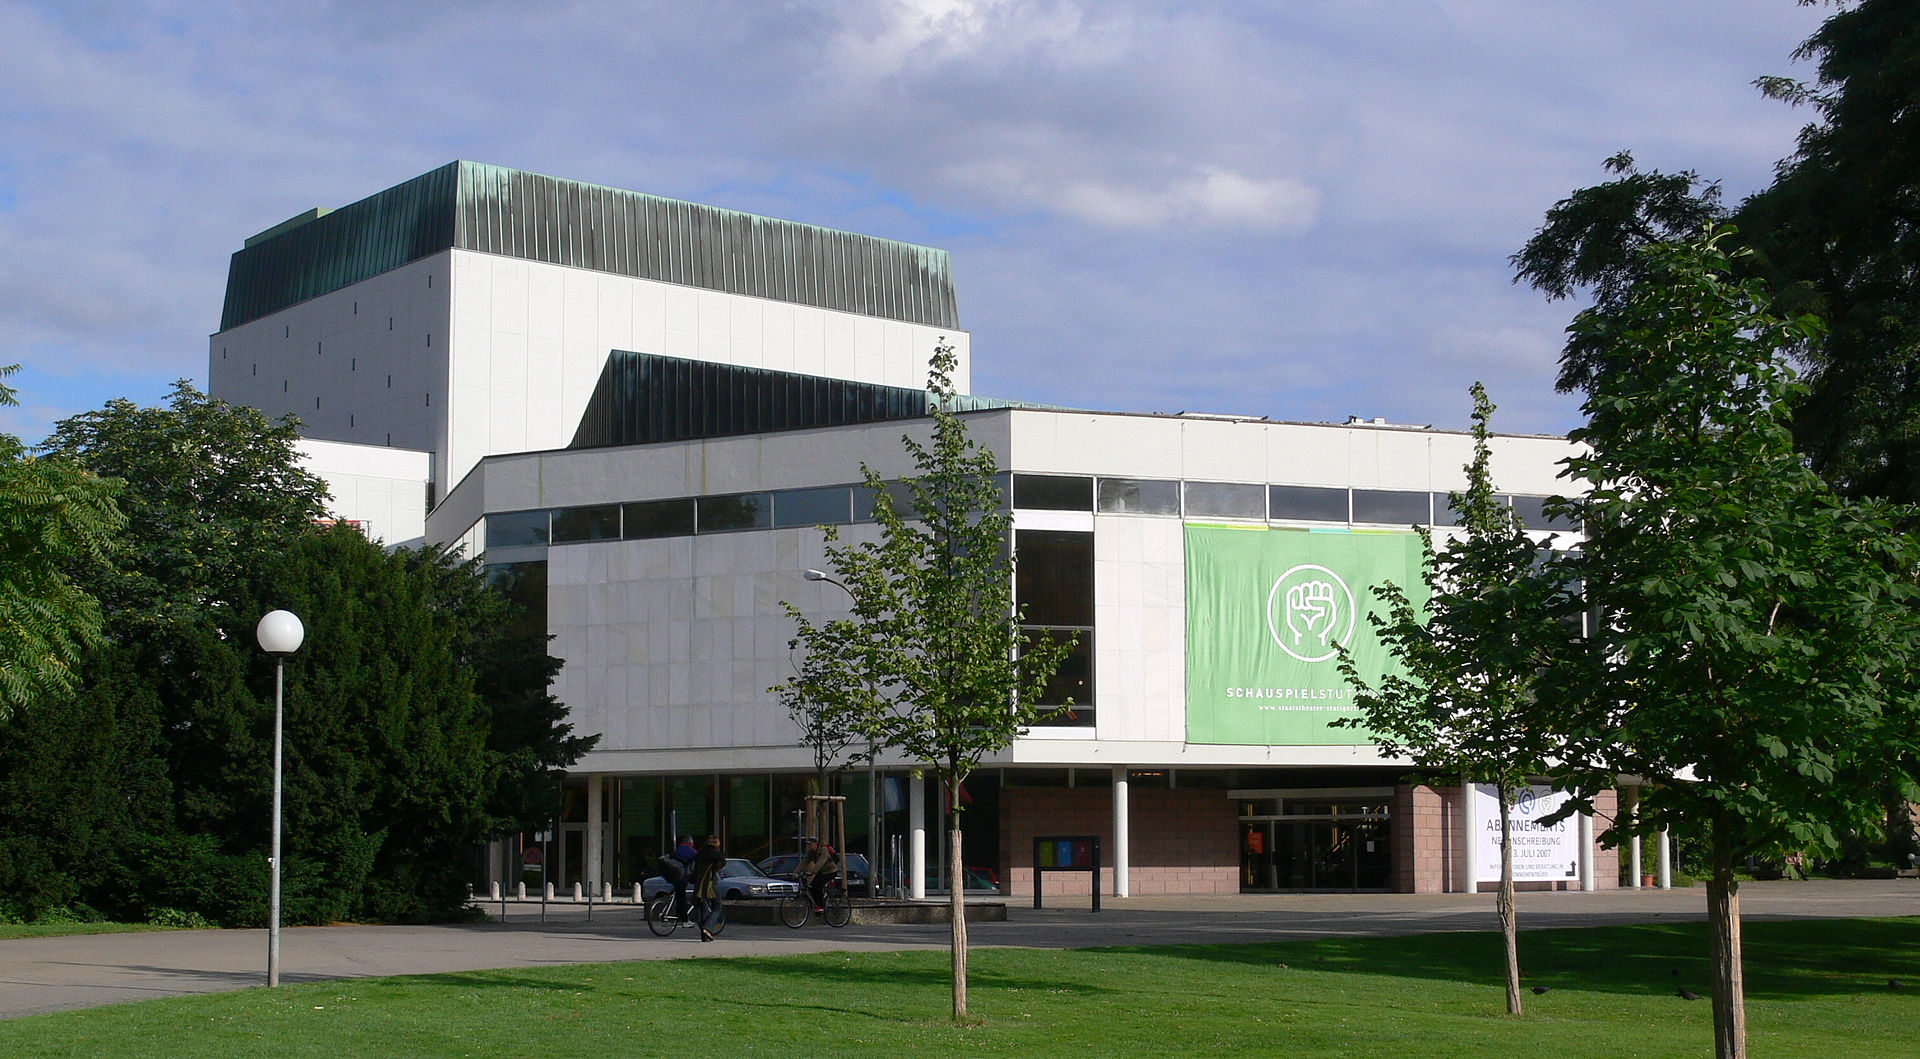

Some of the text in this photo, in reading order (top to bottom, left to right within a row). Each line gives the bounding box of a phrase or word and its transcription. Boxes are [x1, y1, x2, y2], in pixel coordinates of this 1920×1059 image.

[1486, 819, 1566, 832] ABNNEMETS
[1491, 836, 1561, 845] NENSCHREIBUNG
[1520, 849, 1535, 858] JULI
[1536, 849, 1552, 858] 2007
